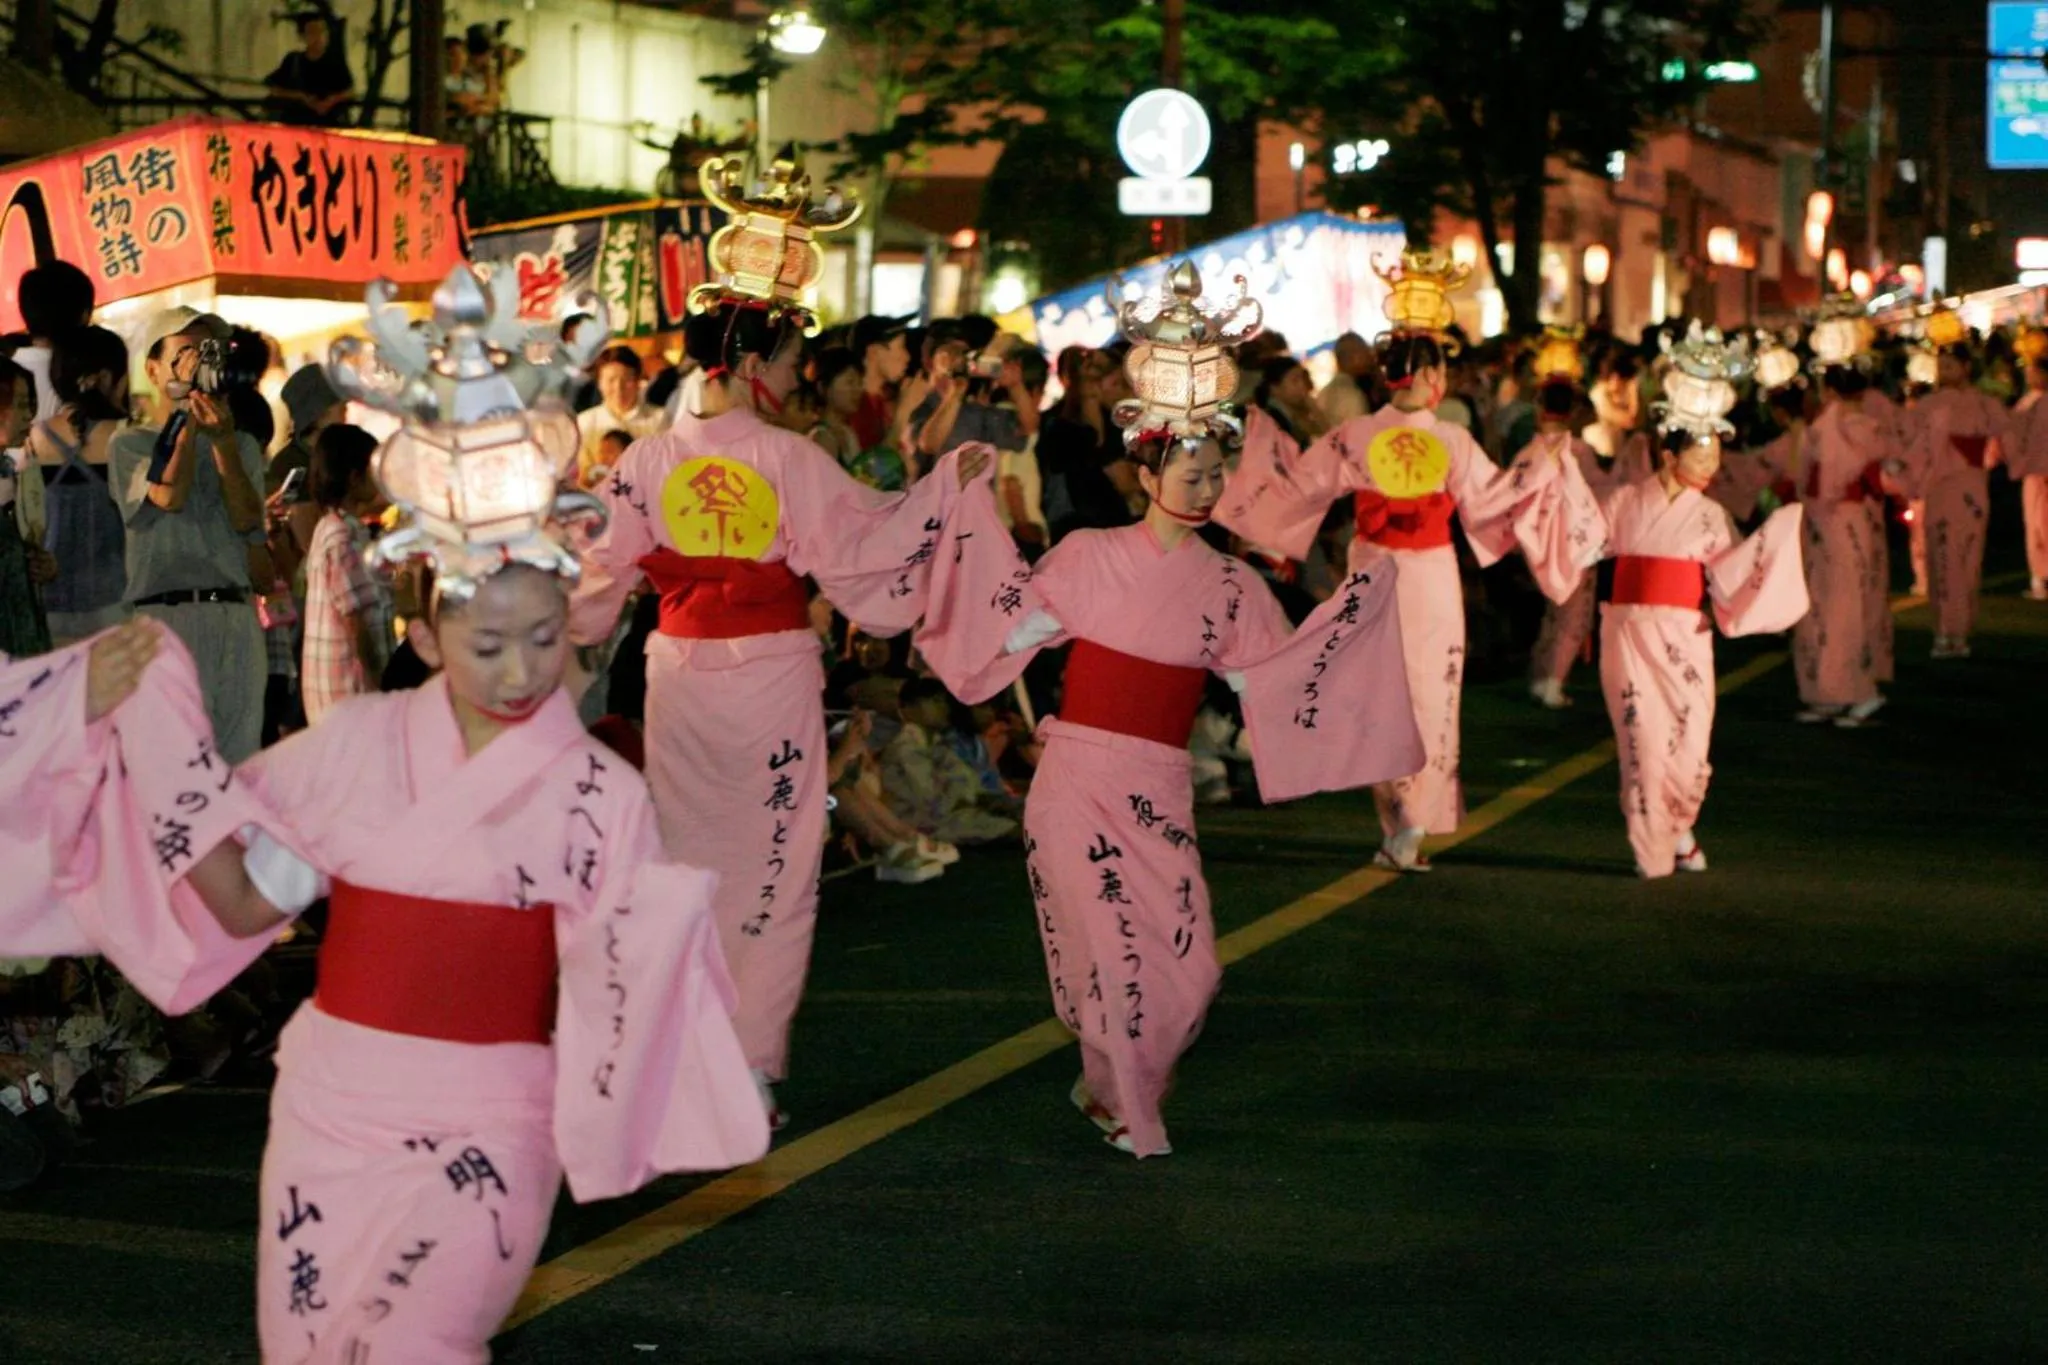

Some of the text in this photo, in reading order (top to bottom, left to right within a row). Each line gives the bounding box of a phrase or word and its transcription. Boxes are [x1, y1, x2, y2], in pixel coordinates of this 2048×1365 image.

[84, 153, 142, 278] 風物詩
[128, 147, 186, 242] 街の
[247, 140, 380, 262] やきとり
[1293, 572, 1371, 729] 山鹿とうろは
